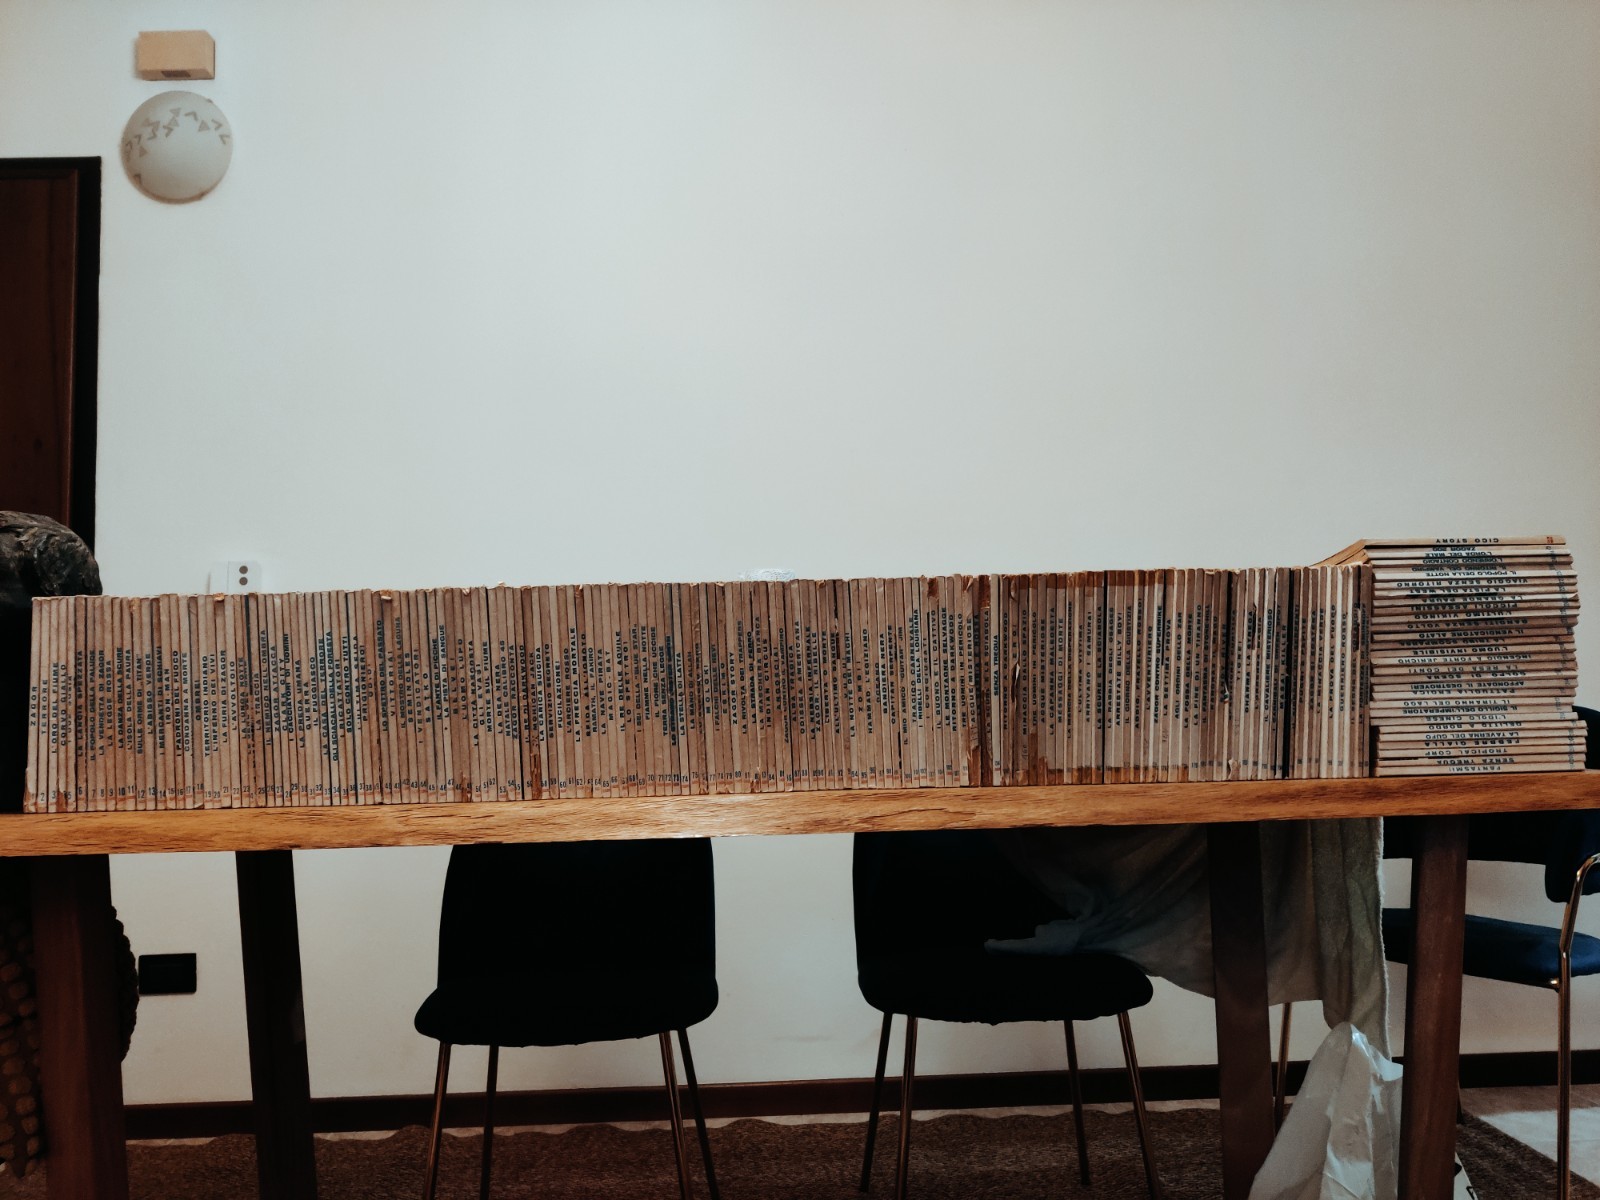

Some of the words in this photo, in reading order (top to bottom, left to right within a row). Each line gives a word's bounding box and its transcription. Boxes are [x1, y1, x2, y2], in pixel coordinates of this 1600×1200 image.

[913, 609, 921, 652] LOUISIANA
[457, 638, 465, 669] LUPO
[482, 641, 490, 671] FIUME
[569, 627, 578, 675] MORTALE
[615, 631, 623, 665] AQUILE
[762, 638, 770, 681] CIRCUS
[794, 621, 803, 682] AMERICANA
[1058, 657, 1063, 666] DI
[1195, 653, 1200, 666] UN
[172, 650, 180, 683] FUOCO
[441, 663, 447, 672] DI
[535, 647, 543, 686] SUICIDA
[596, 648, 604, 683] PIRATA
[959, 661, 965, 671] IN
[1194, 671, 1200, 681] DI
[220, 686, 227, 695] DI
[229, 661, 237, 730] L'AVVOLTOIO
[253, 672, 261, 715] TRACCIA
[309, 656, 318, 713] FUGGIASCO
[343, 666, 351, 704] CONTRO
[404, 652, 413, 723] SEMINOLES
[422, 673, 431, 723] SATKO
[459, 677, 467, 720] L'UOMO
[483, 676, 491, 694] SUL
[880, 663, 888, 714] BANDIERA
[942, 659, 950, 709] MONTAGNE
[303, 681, 312, 730] GUERRA
[443, 707, 450, 718] LA
[564, 684, 572, 733] L'ARCIERE
[572, 679, 580, 725] FRECCIA
[598, 690, 606, 716] NAVE
[618, 705, 625, 718] RE
[764, 687, 772, 727] INDIAN
[797, 688, 805, 734] ODISSEA
[1328, 707, 1334, 719] LA
[1403, 706, 1474, 714] DELL'IMPERATORE
[174, 707, 182, 750] PADRONI
[211, 700, 219, 752] L'INFERNO
[255, 720, 262, 731] LA
[312, 718, 319, 726] IL
[497, 721, 503, 734] LA
[600, 723, 607, 735] LA
[619, 723, 625, 732] IL
[944, 715, 950, 726] LE
[1193, 713, 1199, 726] LA
[1264, 714, 1269, 722] IL
[107, 735, 113, 746] LA
[222, 732, 228, 743] LA
[538, 730, 545, 742] LA
[575, 730, 581, 742] LA
